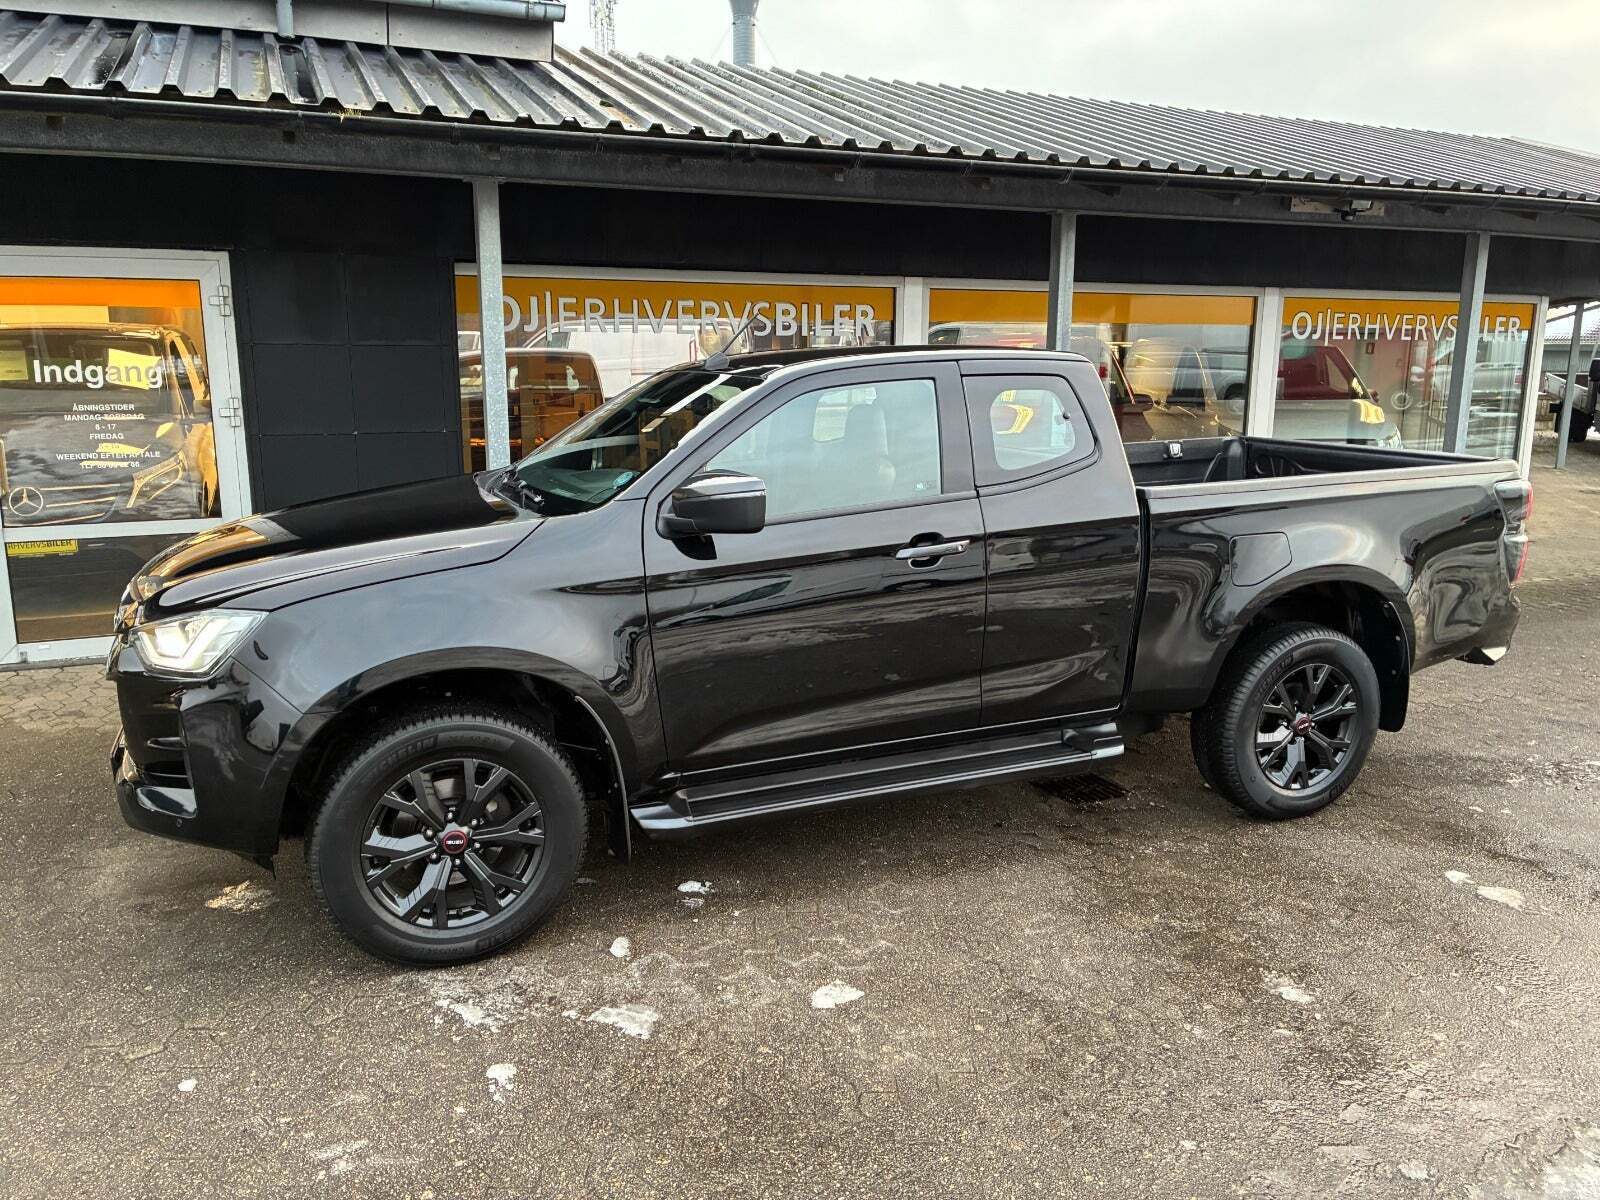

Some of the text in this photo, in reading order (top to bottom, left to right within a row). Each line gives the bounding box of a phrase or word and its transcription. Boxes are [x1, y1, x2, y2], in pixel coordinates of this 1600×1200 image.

[33, 359, 163, 389] Indgang
[72, 403, 135, 412] ÅBNINGSTIDER
[56, 452, 98, 461] WEEKEND
